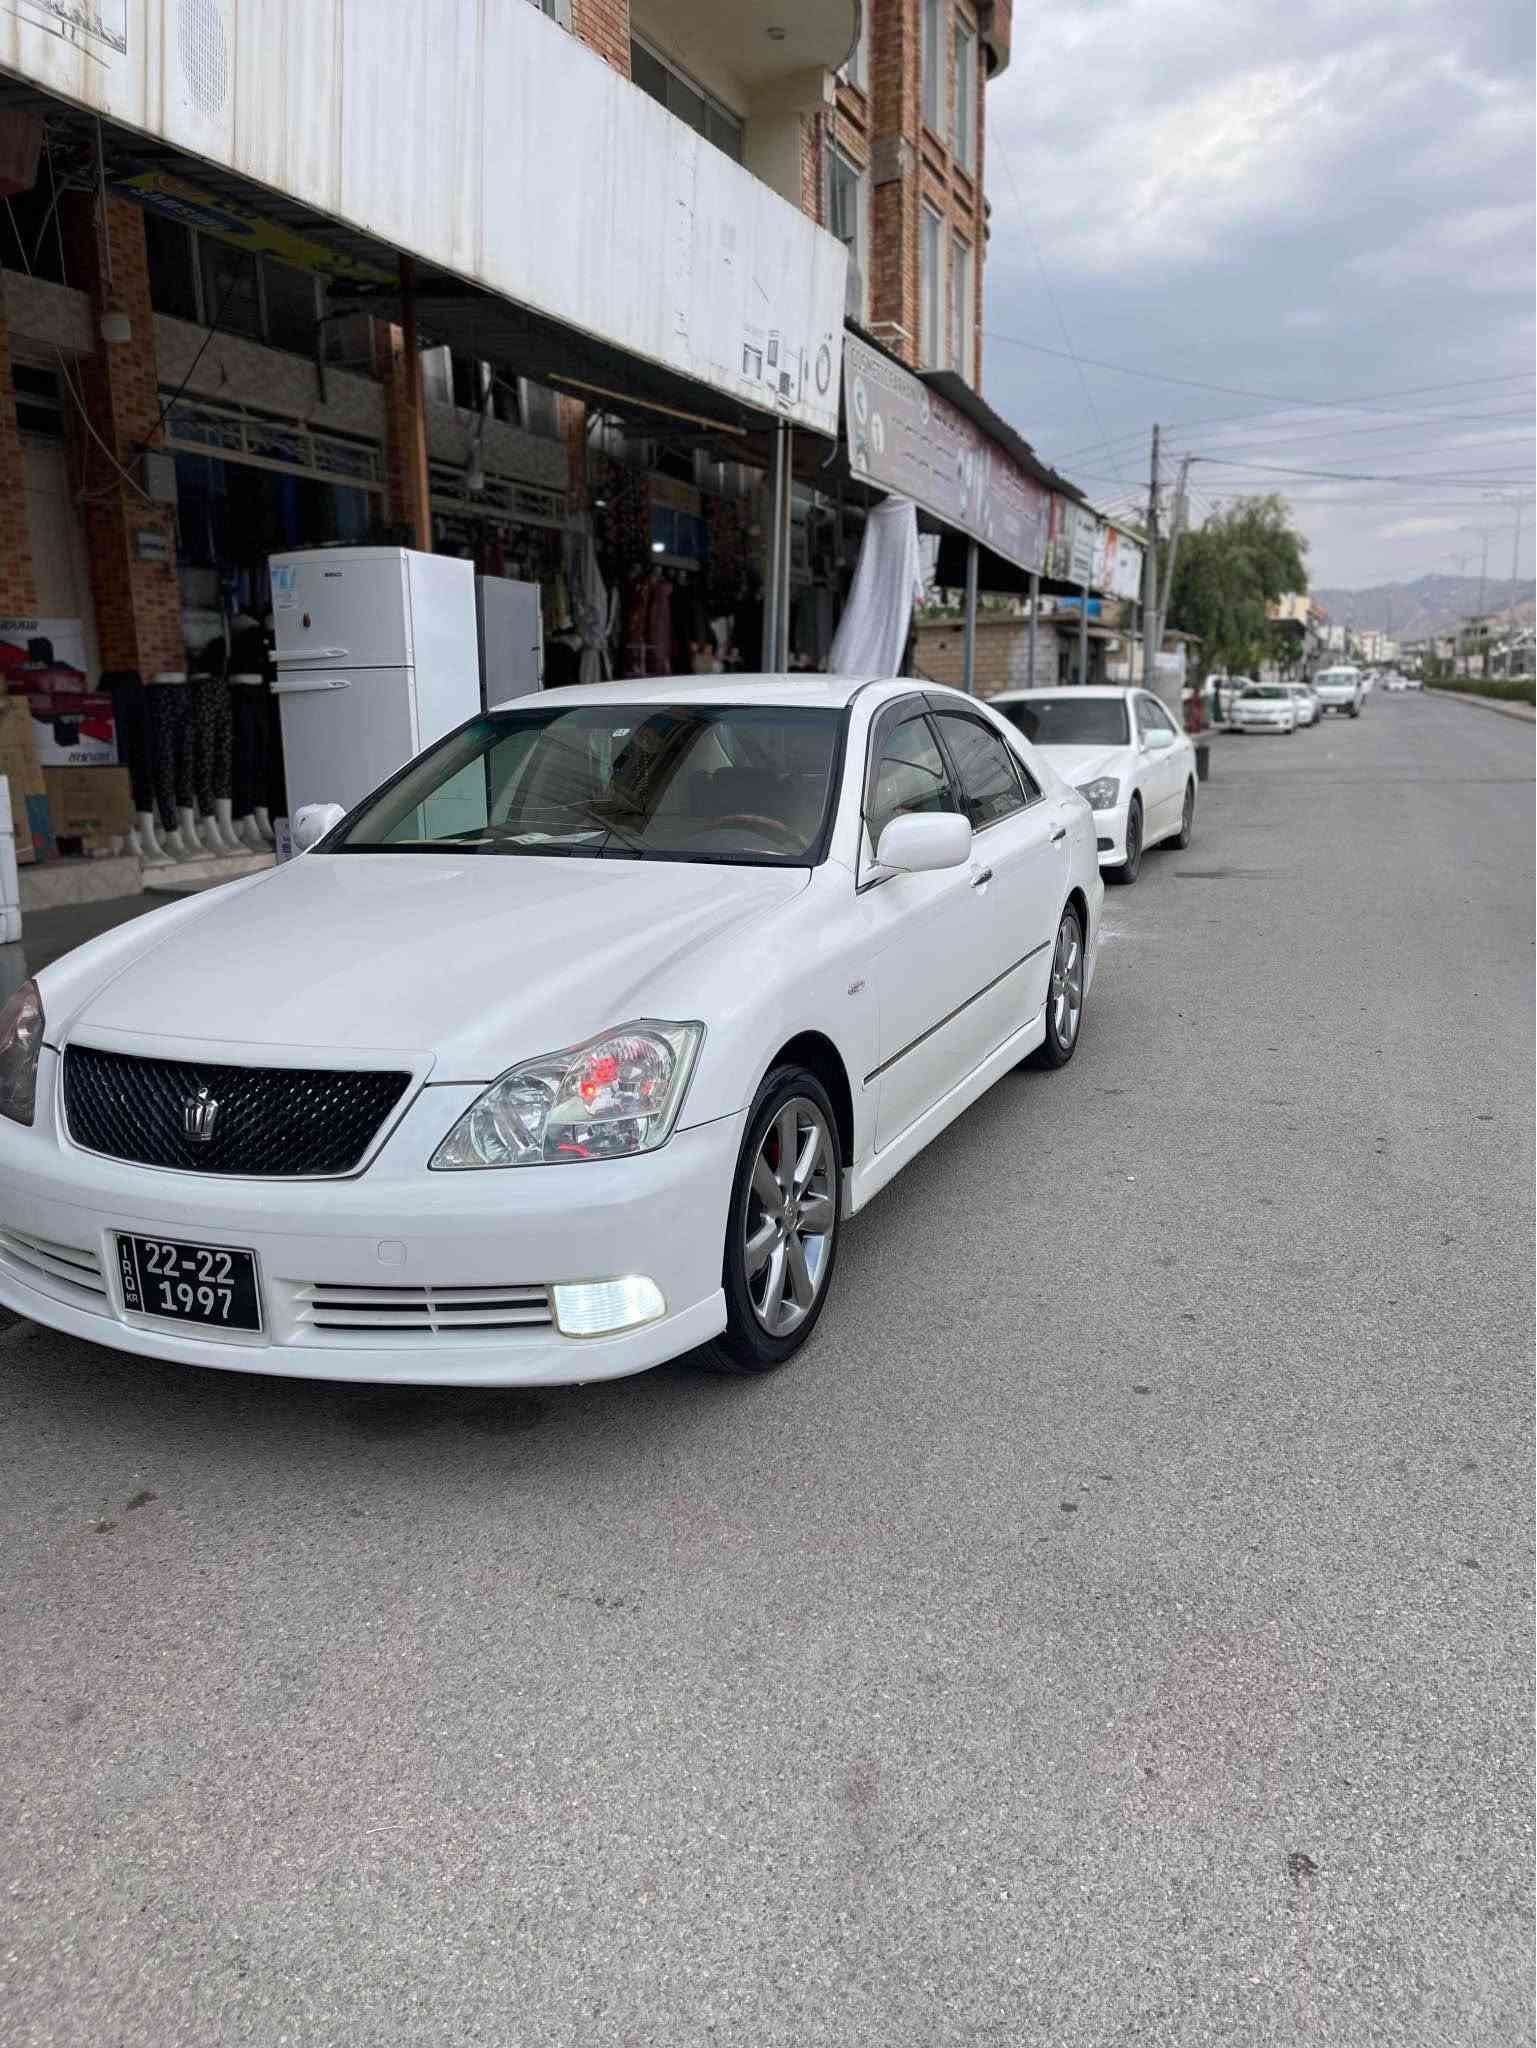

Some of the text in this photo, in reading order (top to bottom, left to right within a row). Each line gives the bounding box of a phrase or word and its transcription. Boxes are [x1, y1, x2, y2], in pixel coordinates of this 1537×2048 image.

[122, 1243, 136, 1291] IRQ
[145, 1242, 235, 1285] 22-22
[159, 1280, 232, 1319] 1997
